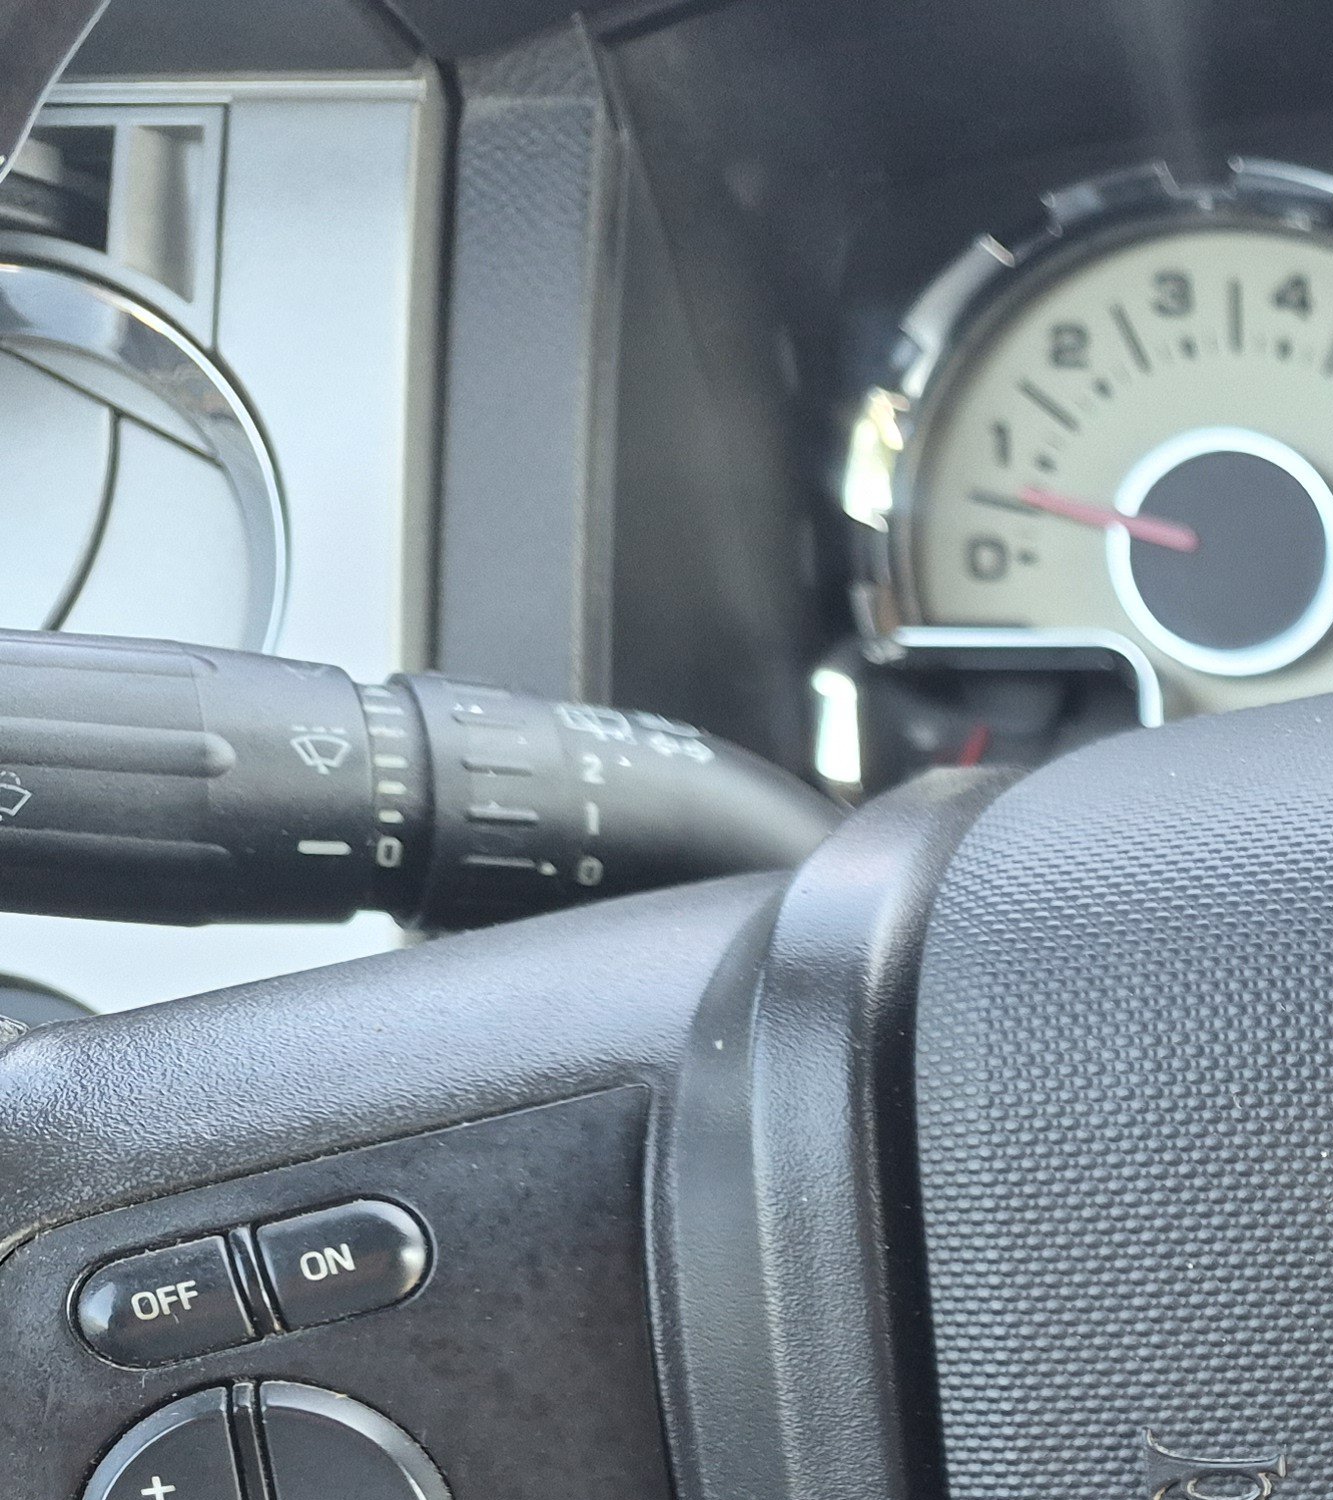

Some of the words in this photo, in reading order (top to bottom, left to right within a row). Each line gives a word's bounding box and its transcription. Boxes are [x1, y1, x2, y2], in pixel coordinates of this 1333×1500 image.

[1153, 269, 1194, 318] 3
[1272, 272, 1313, 322] 4
[1048, 321, 1090, 370] 2
[991, 418, 1011, 468] 1
[965, 534, 1008, 583] 0
[582, 752, 605, 785] 2
[376, 835, 403, 868] 0
[299, 1243, 356, 1282] ON
[130, 1279, 200, 1321] OFF
